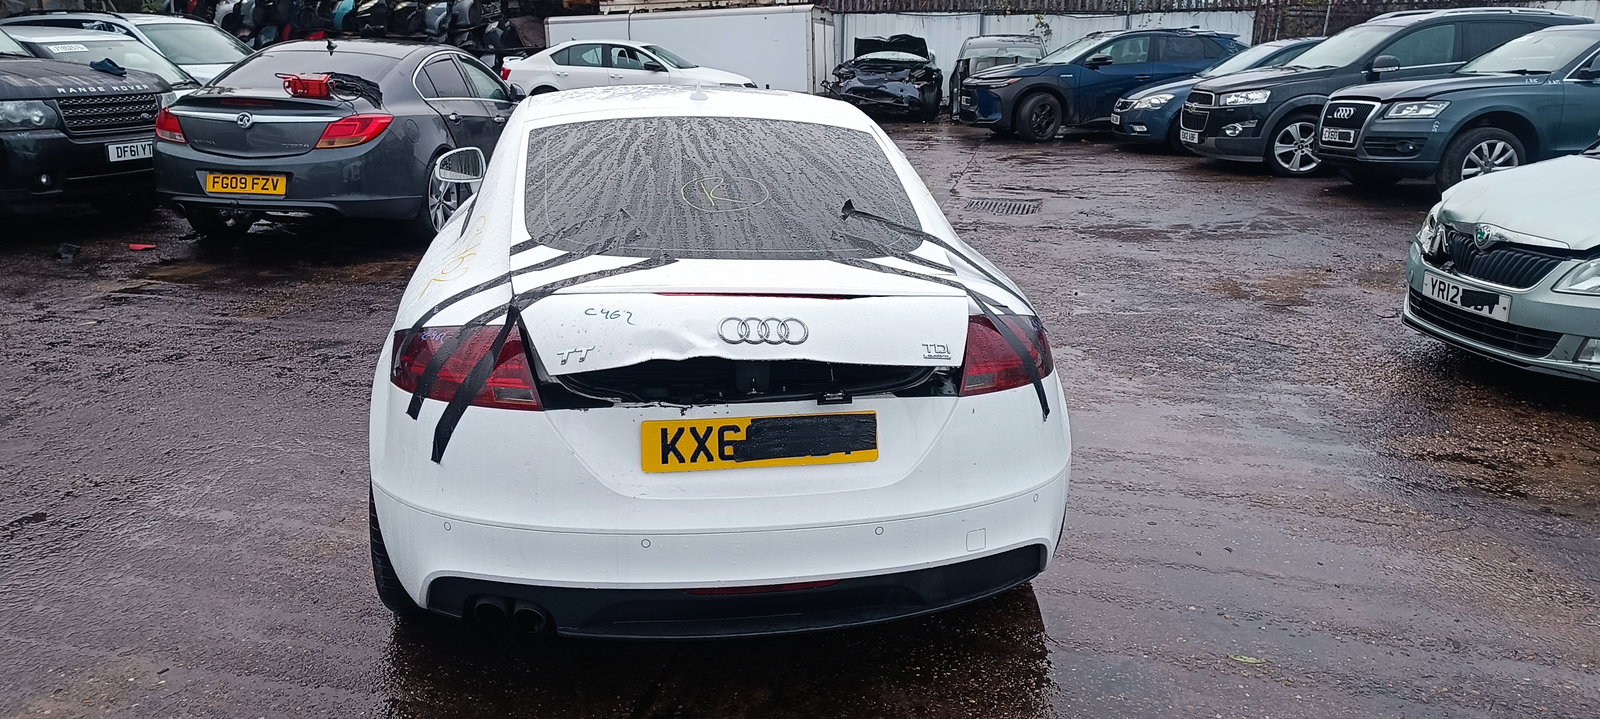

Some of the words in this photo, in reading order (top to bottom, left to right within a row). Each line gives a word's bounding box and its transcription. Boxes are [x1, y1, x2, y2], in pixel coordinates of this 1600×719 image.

[56, 86, 106, 94] RANGE
[111, 83, 150, 92] ROVER
[115, 145, 139, 159] DF61
[212, 175, 247, 190] FG09
[251, 177, 279, 191] FZV
[1430, 277, 1460, 305] YR12
[556, 345, 596, 366] TT
[921, 343, 951, 355] TDI
[660, 424, 752, 465] KX6
